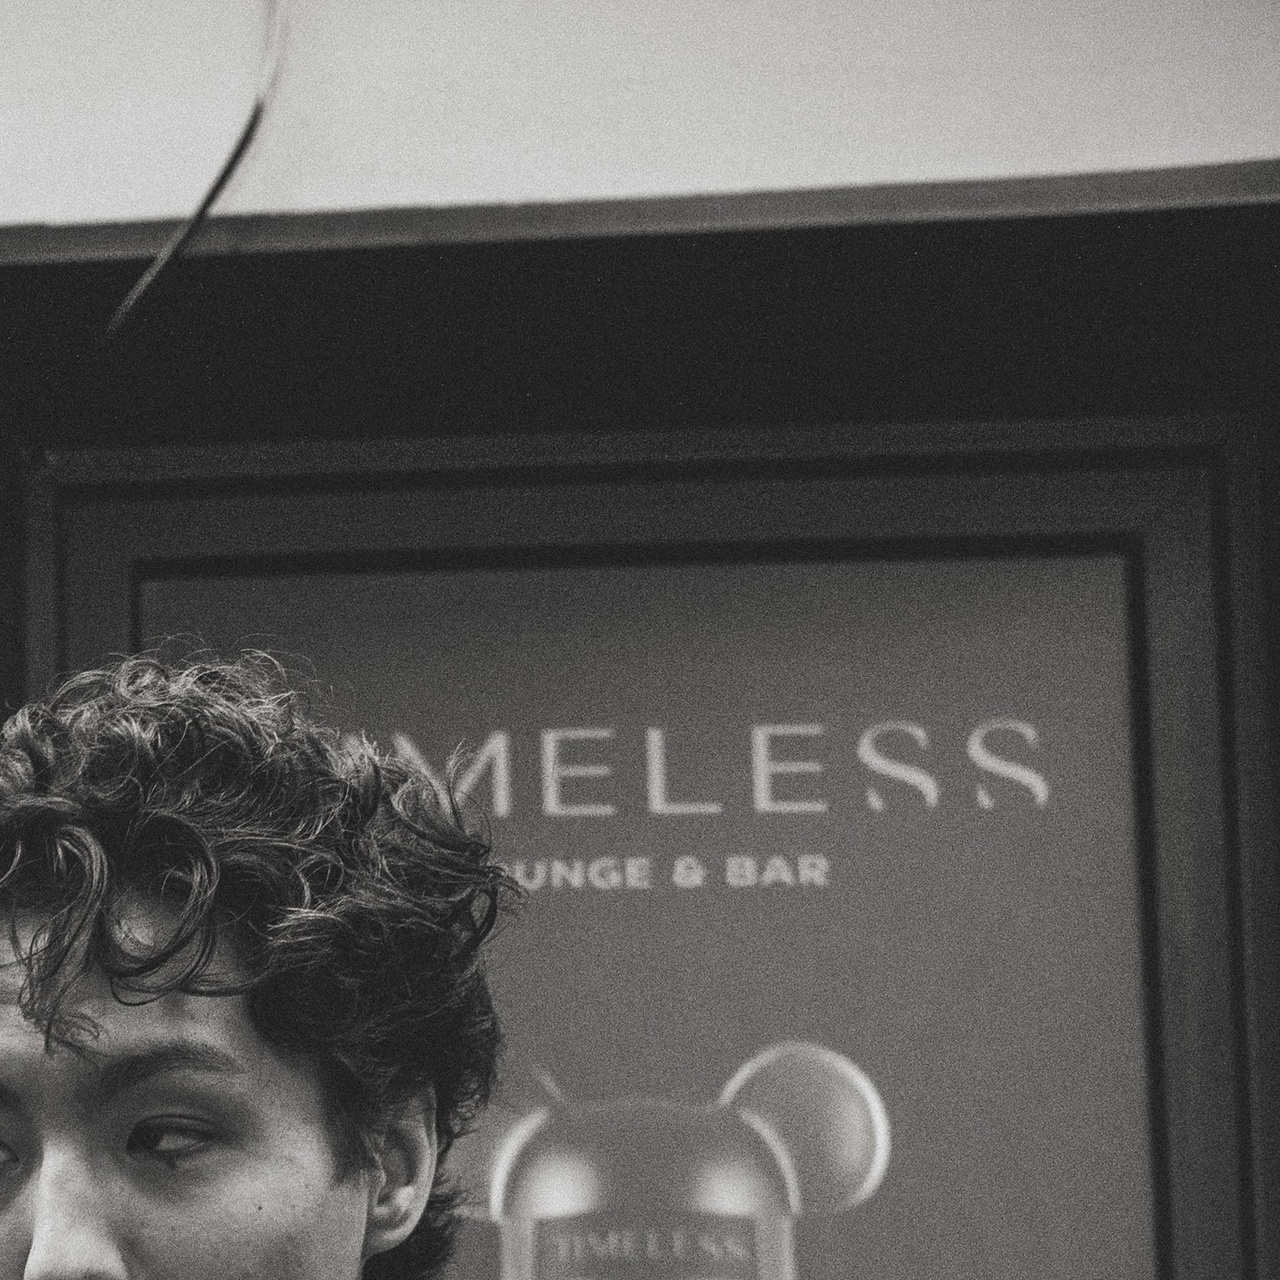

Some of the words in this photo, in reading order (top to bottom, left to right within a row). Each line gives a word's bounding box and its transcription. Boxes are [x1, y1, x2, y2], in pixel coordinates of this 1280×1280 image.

[340, 717, 1050, 820] MELESS
[506, 856, 652, 891] UNGE
[672, 856, 706, 888] &
[725, 854, 832, 888] BAR
